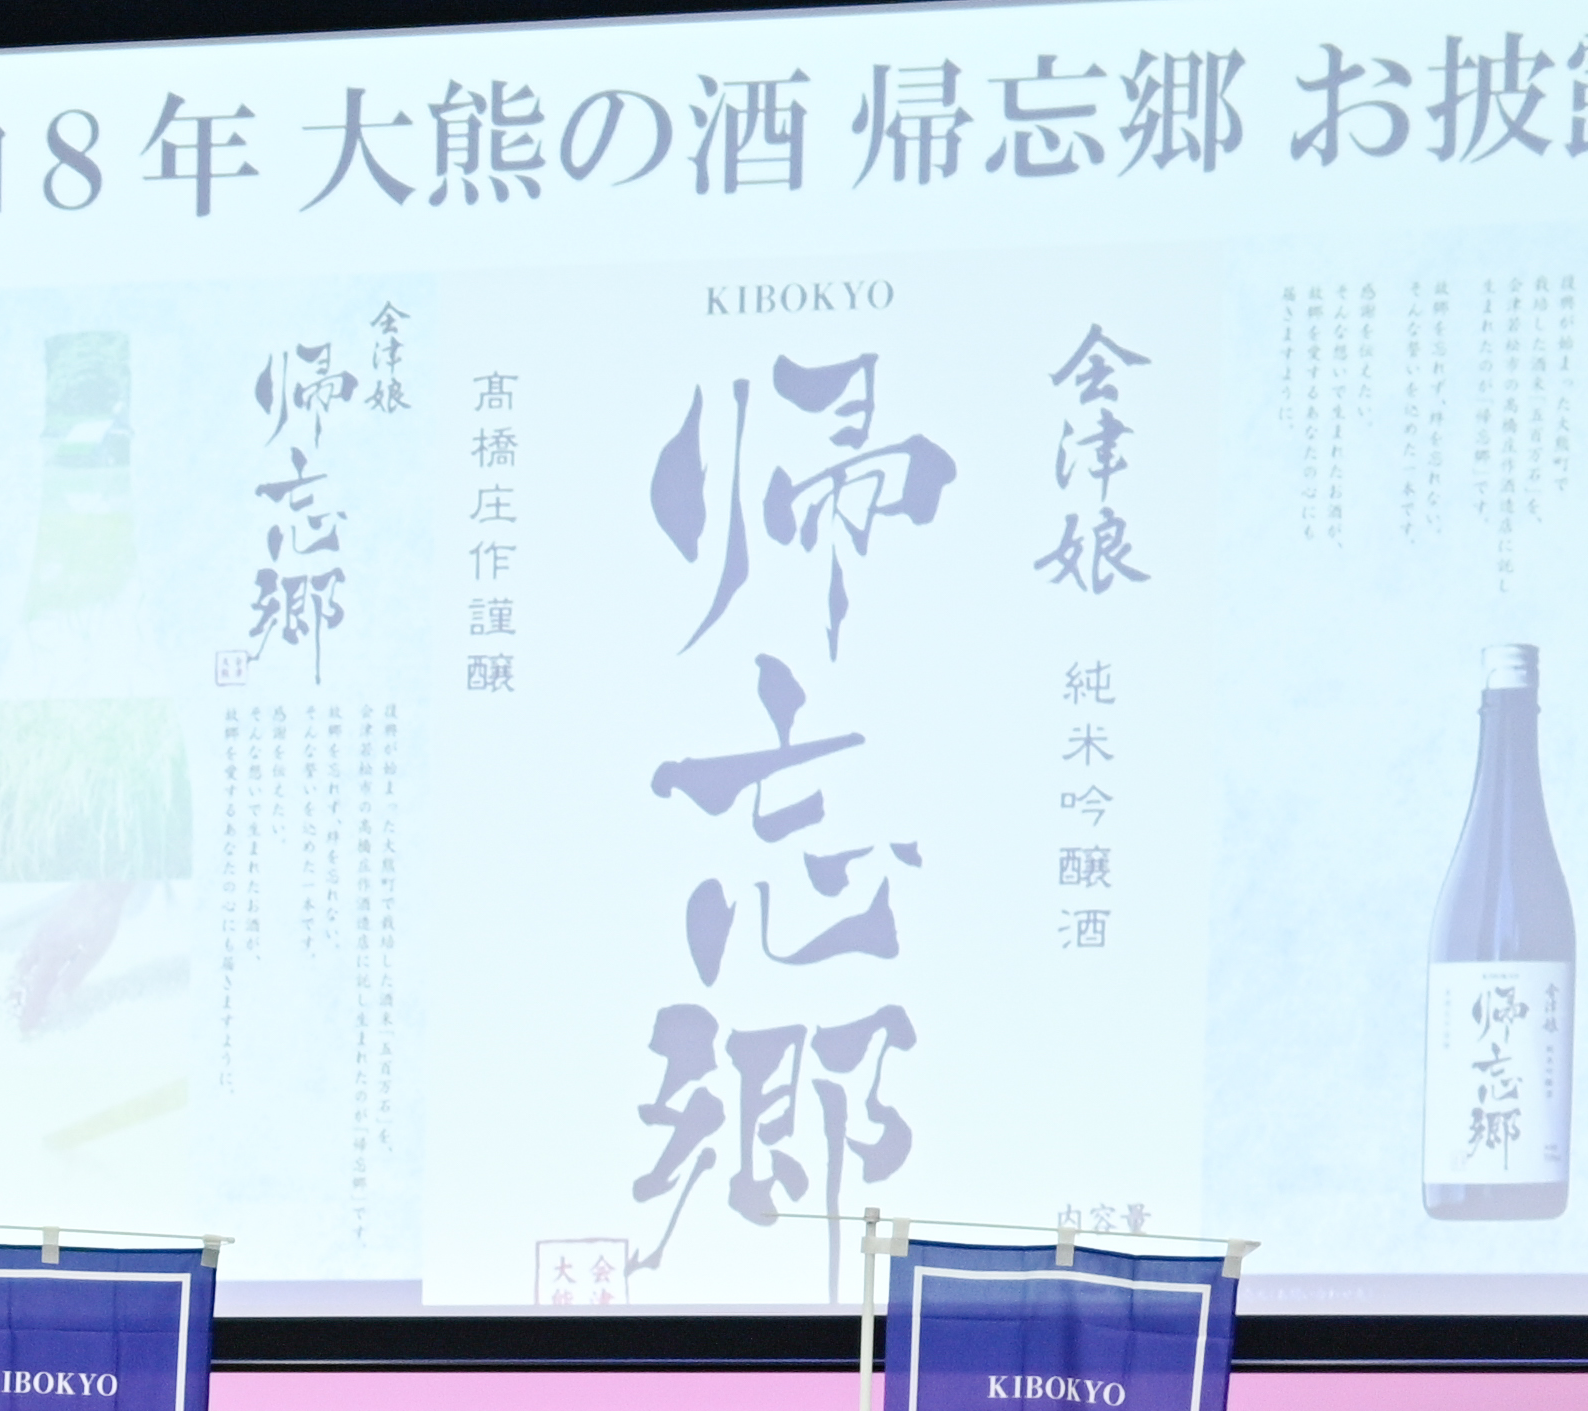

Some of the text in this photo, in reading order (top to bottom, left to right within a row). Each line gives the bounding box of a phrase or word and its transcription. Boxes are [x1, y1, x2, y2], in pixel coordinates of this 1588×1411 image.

[300, 67, 811, 213] 大熊の酒
[851, 47, 1246, 190] 帰忘郷
[1291, 32, 1588, 168] お披
[365, 299, 412, 415] 会津娘
[704, 278, 894, 316] KIBOKYO
[247, 342, 358, 686] 帰忘郷
[1033, 322, 1152, 949] 会津娘 純米吟醸酒
[625, 352, 957, 1303] 帰忘郷
[1467, 986, 1529, 1171] 帰忘郷
[987, 1374, 1126, 1407] KIBOKYO
